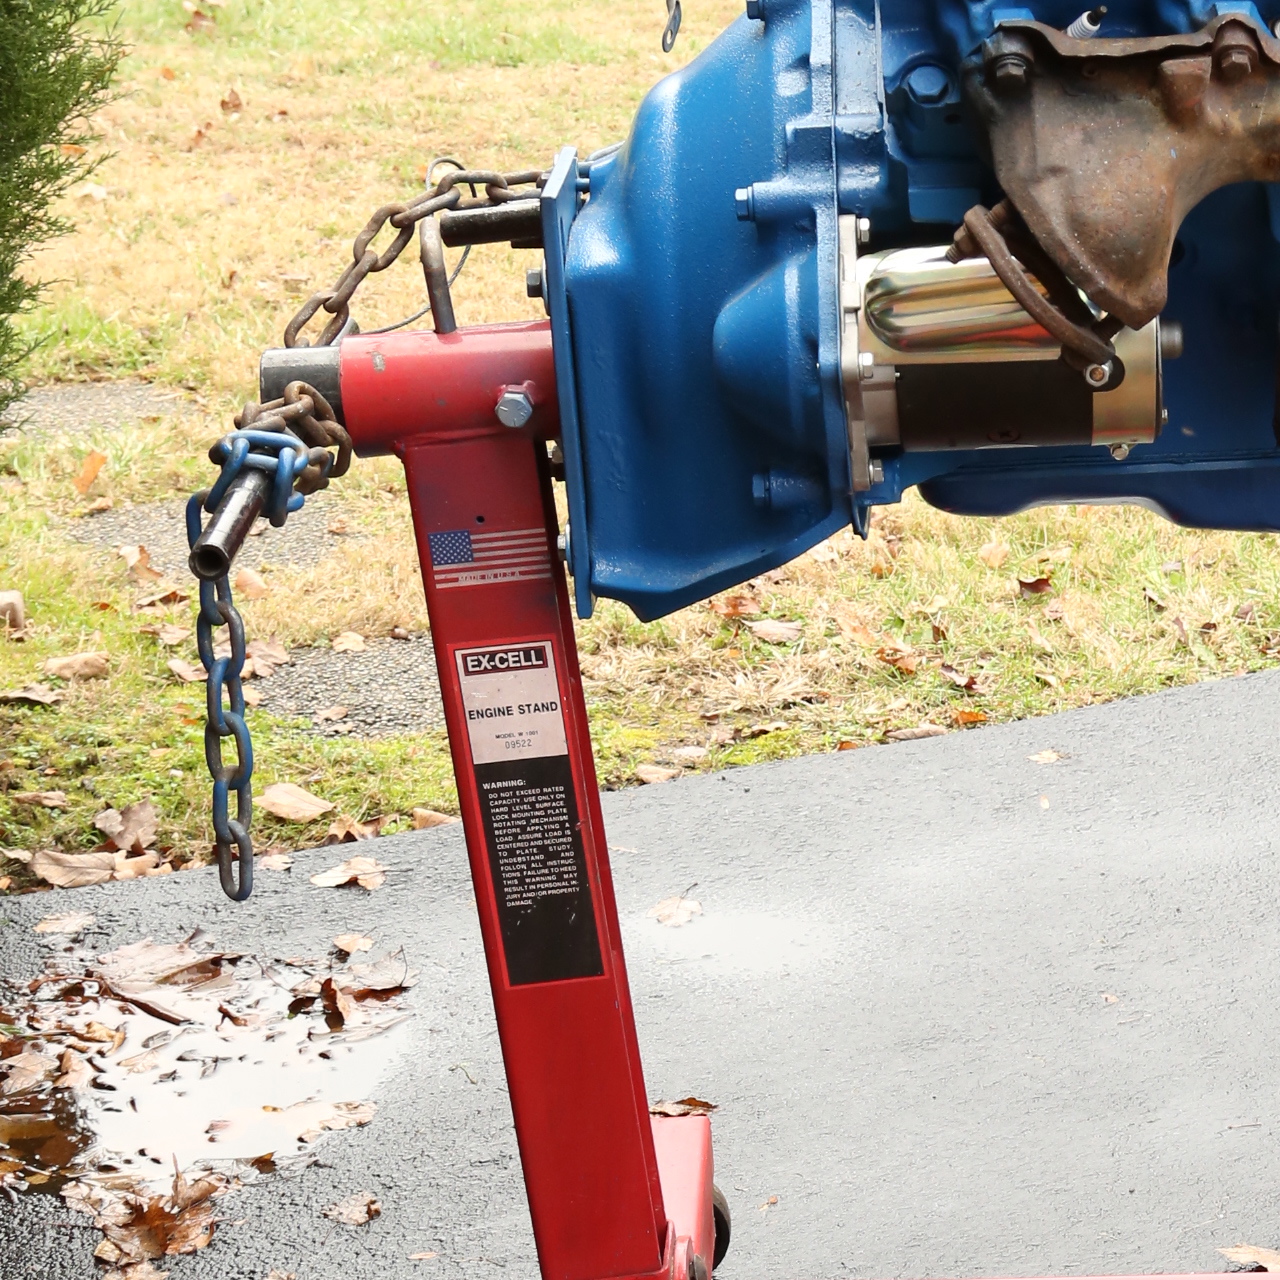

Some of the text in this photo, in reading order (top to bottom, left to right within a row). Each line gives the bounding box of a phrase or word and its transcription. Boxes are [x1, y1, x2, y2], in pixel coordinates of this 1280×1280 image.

[467, 650, 543, 672] EX-CELL
[468, 702, 558, 720] ENGINE STAND
[505, 739, 532, 749] 09522
[483, 780, 526, 789] WARNING:
[512, 810, 545, 818] MOUNTING
[493, 815, 568, 828] ROTATING MECHANISM
[525, 875, 556, 883] WARNING
[537, 881, 569, 889] PERSONAL
[506, 892, 520, 900] JURY
[548, 887, 580, 895] PROPERTY
